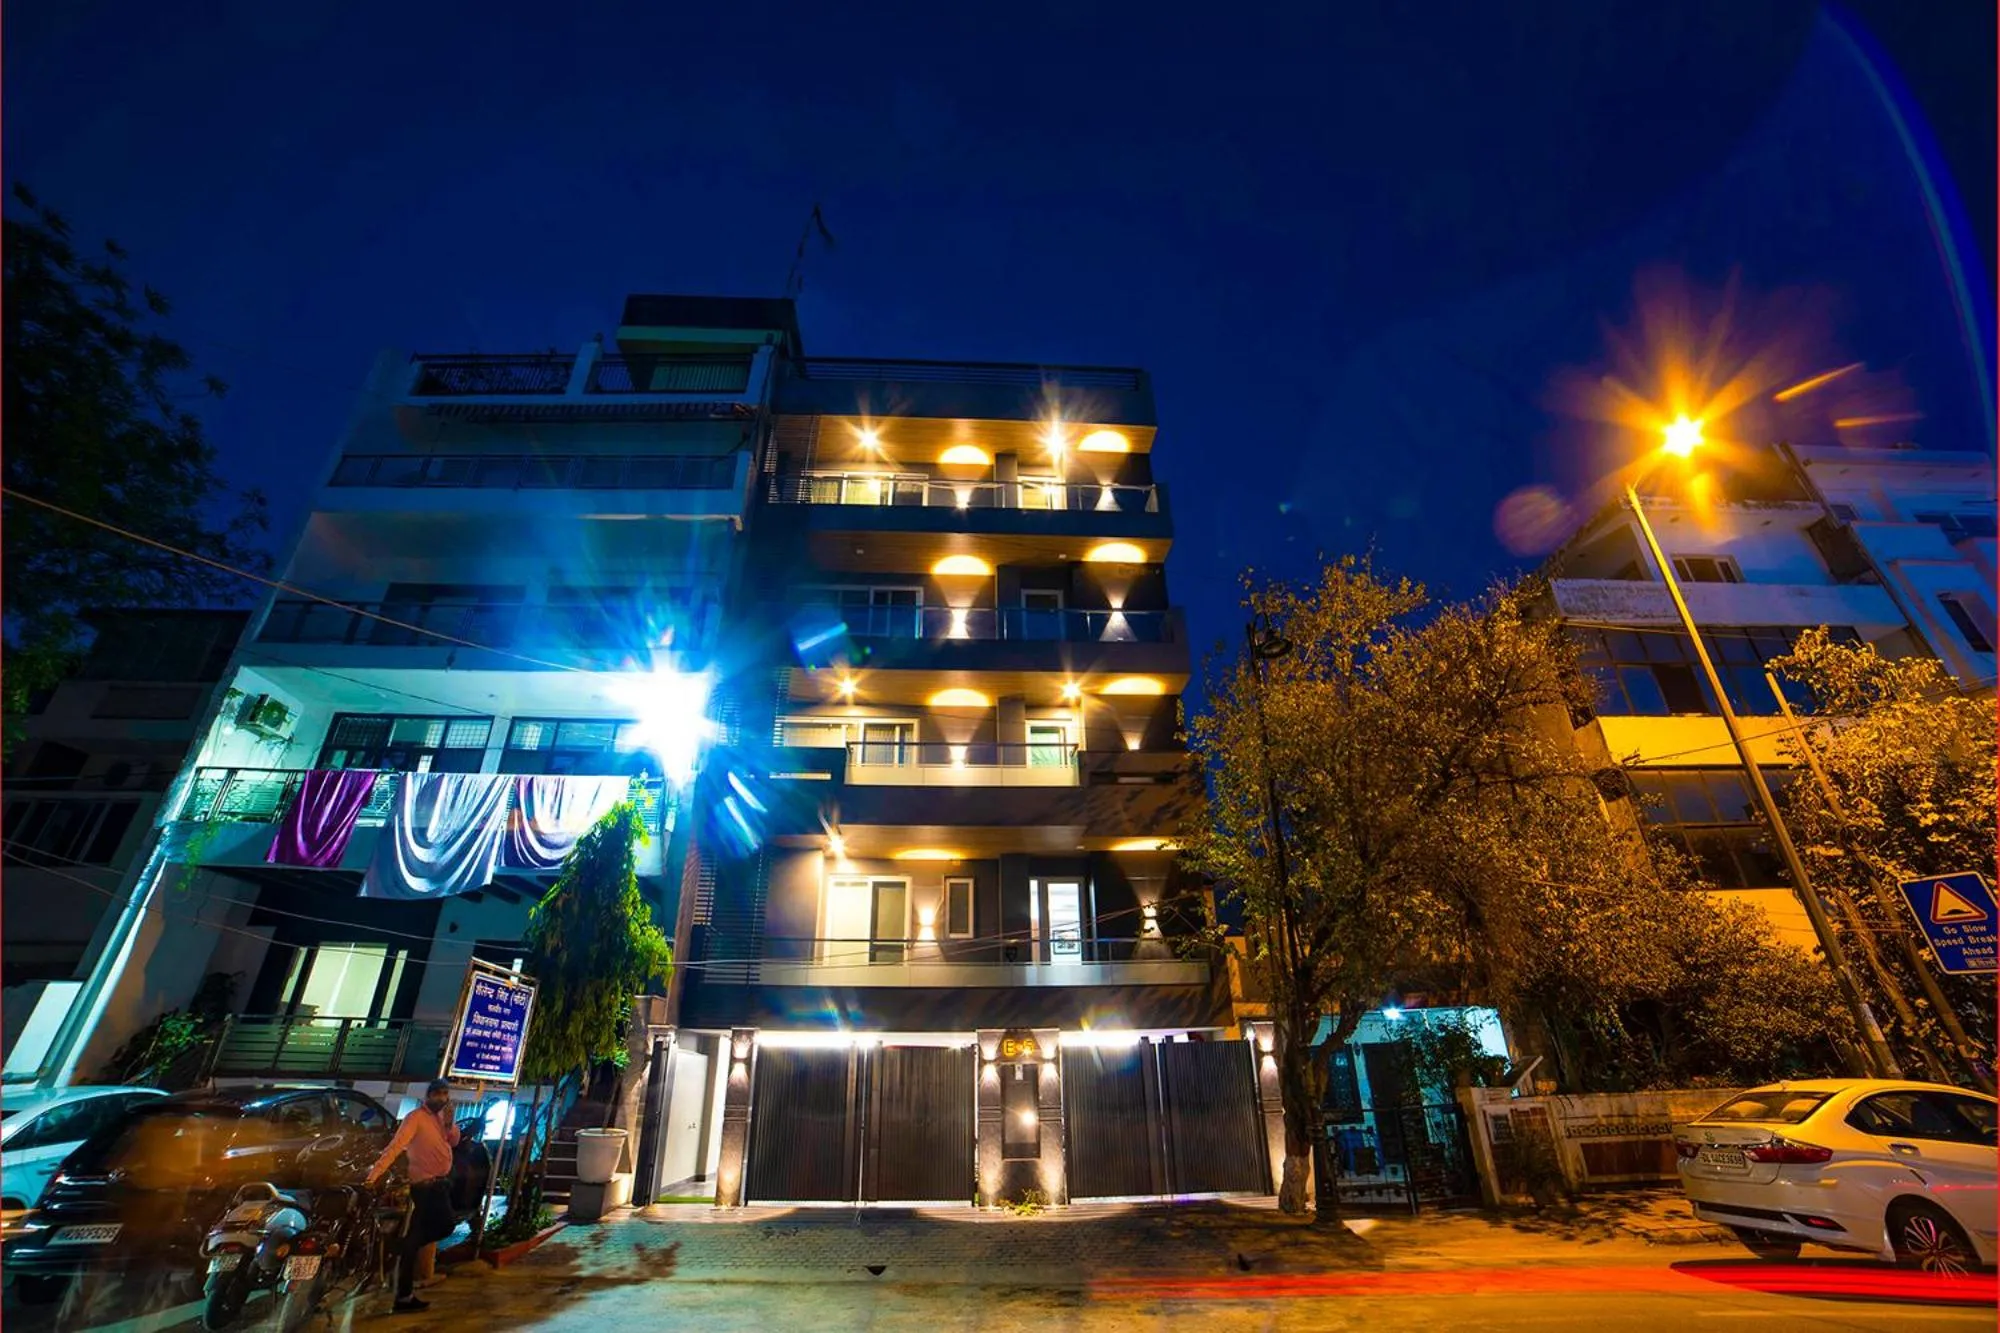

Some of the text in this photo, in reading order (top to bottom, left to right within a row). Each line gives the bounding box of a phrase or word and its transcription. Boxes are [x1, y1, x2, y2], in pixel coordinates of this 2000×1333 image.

[1943, 925, 1987, 935] Go Slow
[1933, 937, 1965, 947] Speed
[1962, 946, 1995, 956] Ahead
